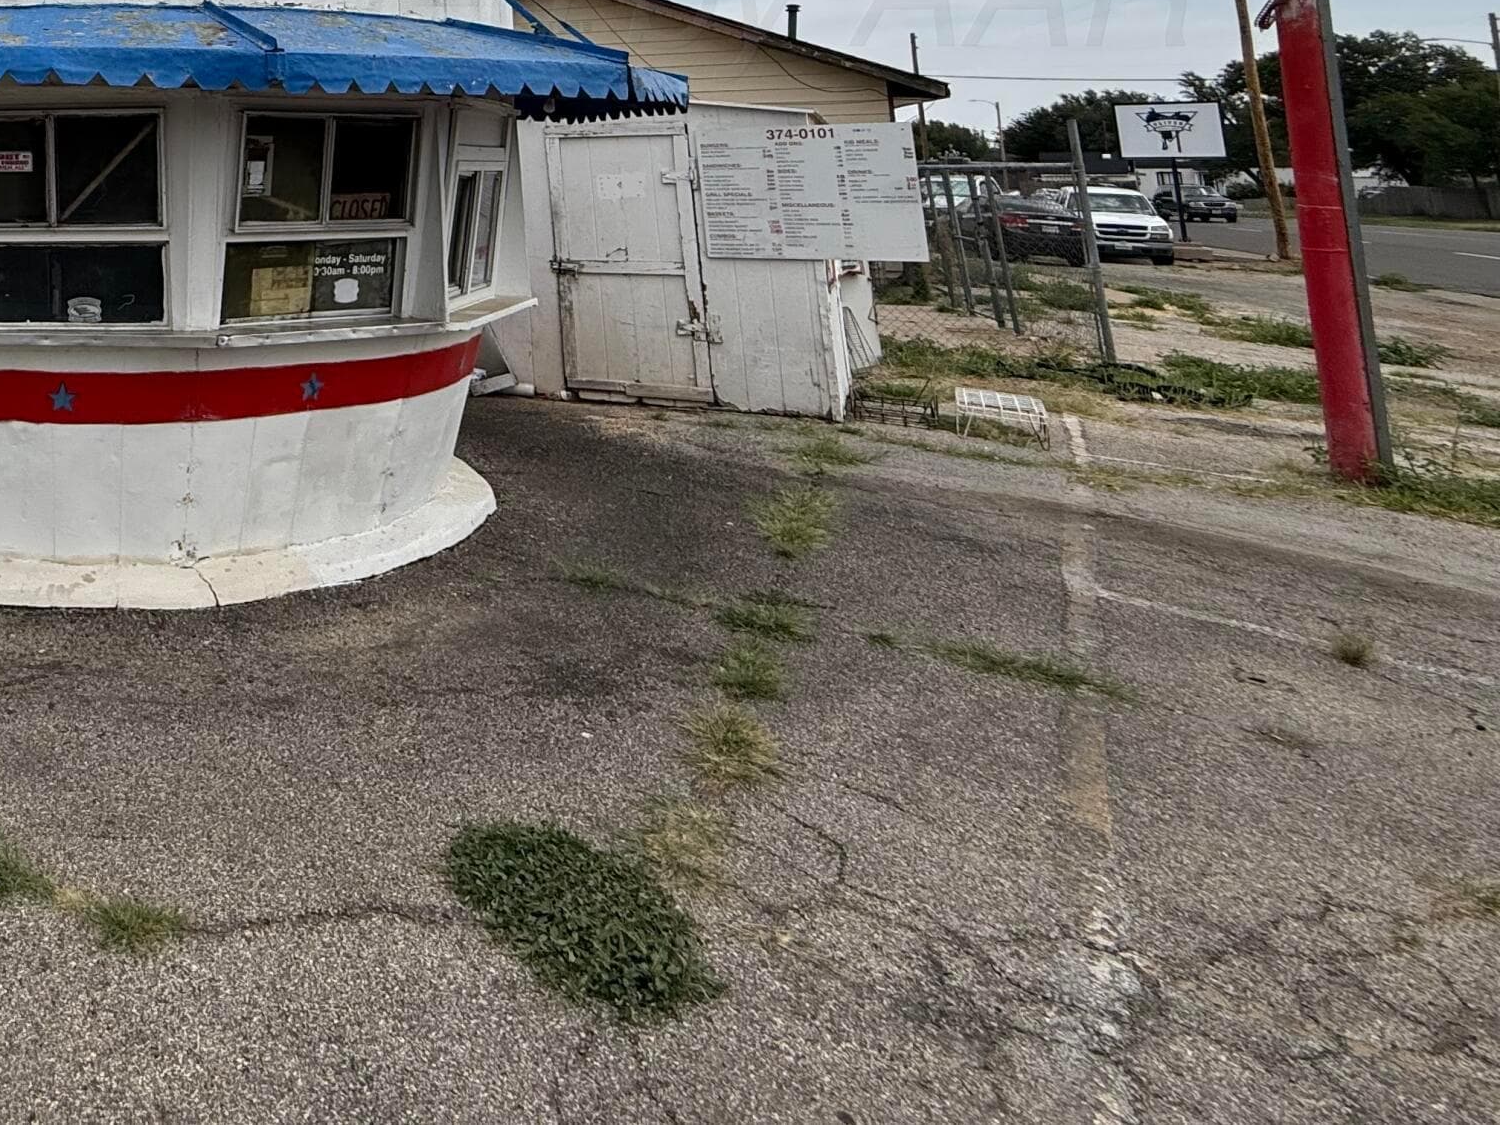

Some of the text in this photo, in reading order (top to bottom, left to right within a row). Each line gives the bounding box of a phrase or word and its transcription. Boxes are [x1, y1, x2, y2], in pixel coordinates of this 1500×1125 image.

[766, 128, 835, 140] 374-0101
[314, 255, 341, 266] onday
[349, 253, 386, 264] Saturday
[352, 265, 384, 276] 8:00pm
